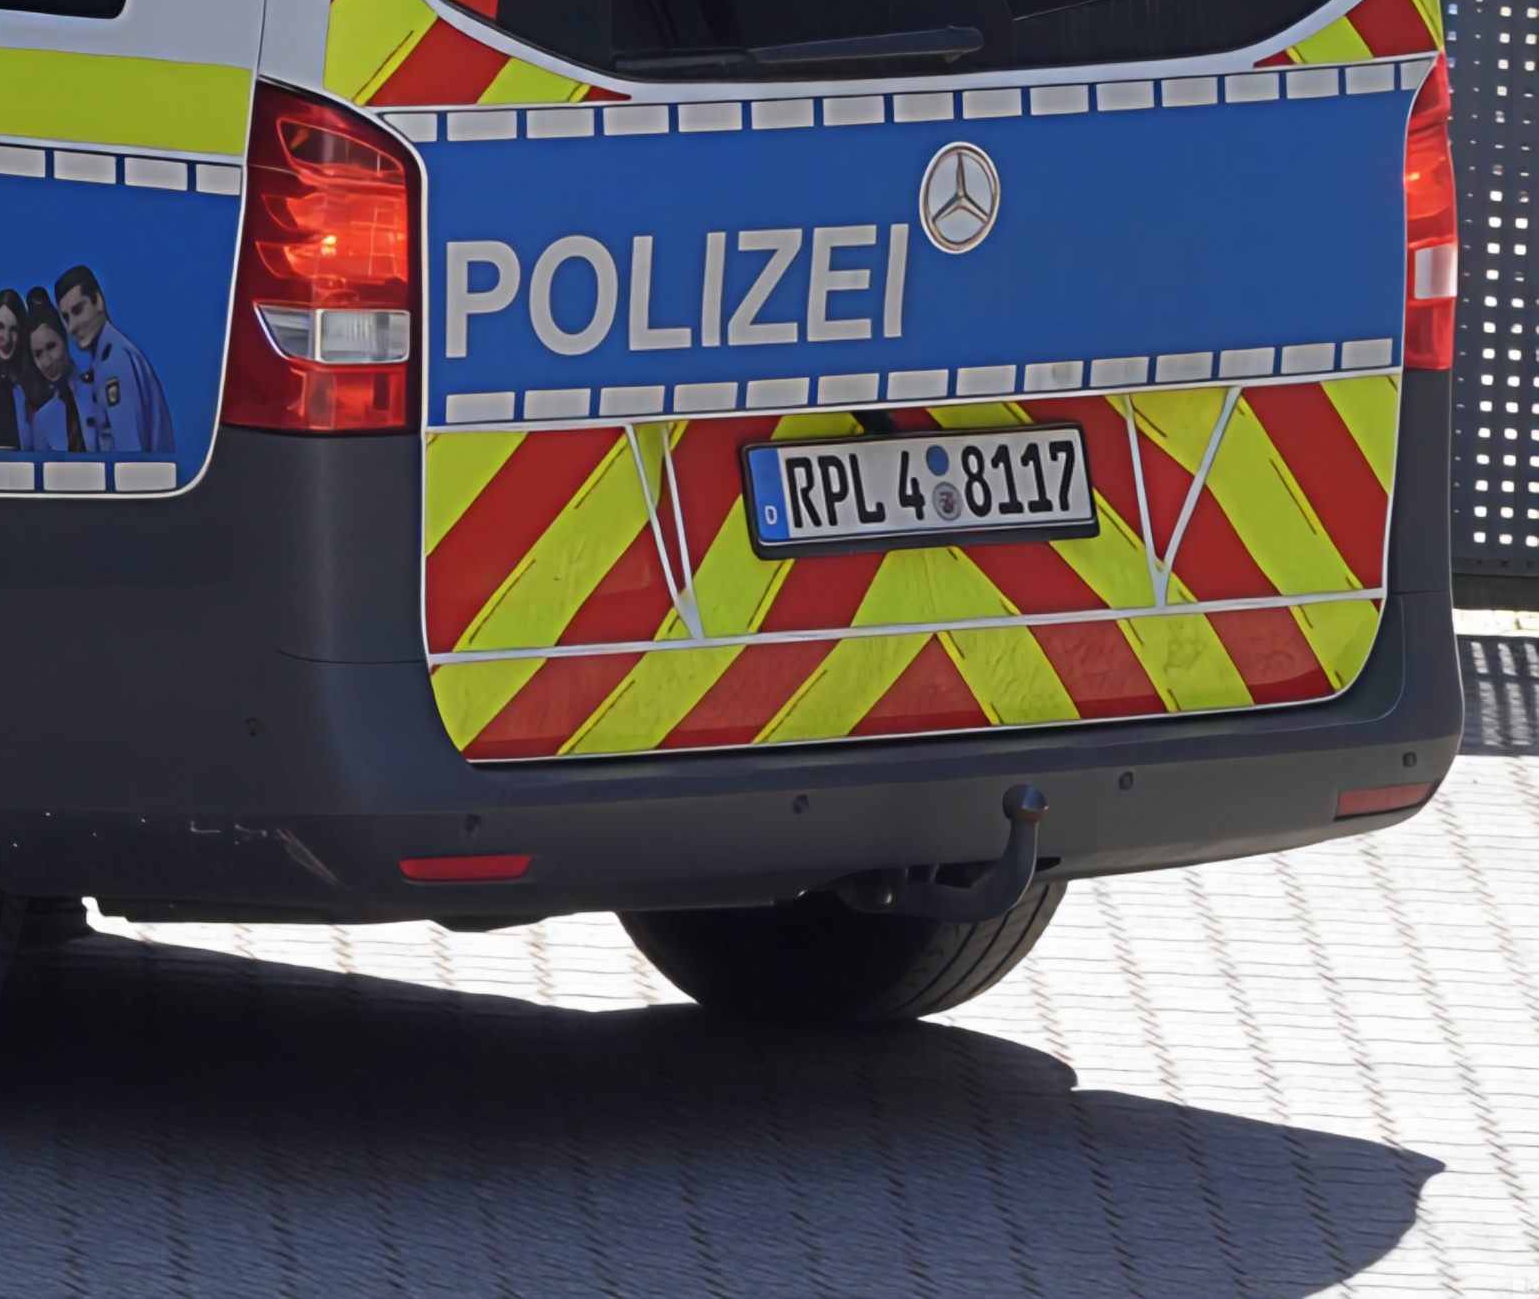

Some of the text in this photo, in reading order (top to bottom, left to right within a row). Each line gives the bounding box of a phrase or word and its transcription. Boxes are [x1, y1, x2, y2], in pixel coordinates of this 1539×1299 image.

[444, 222, 910, 360] POLIZEI
[785, 452, 886, 529] RPL
[898, 450, 926, 521] 4
[960, 439, 1076, 519] 8117
